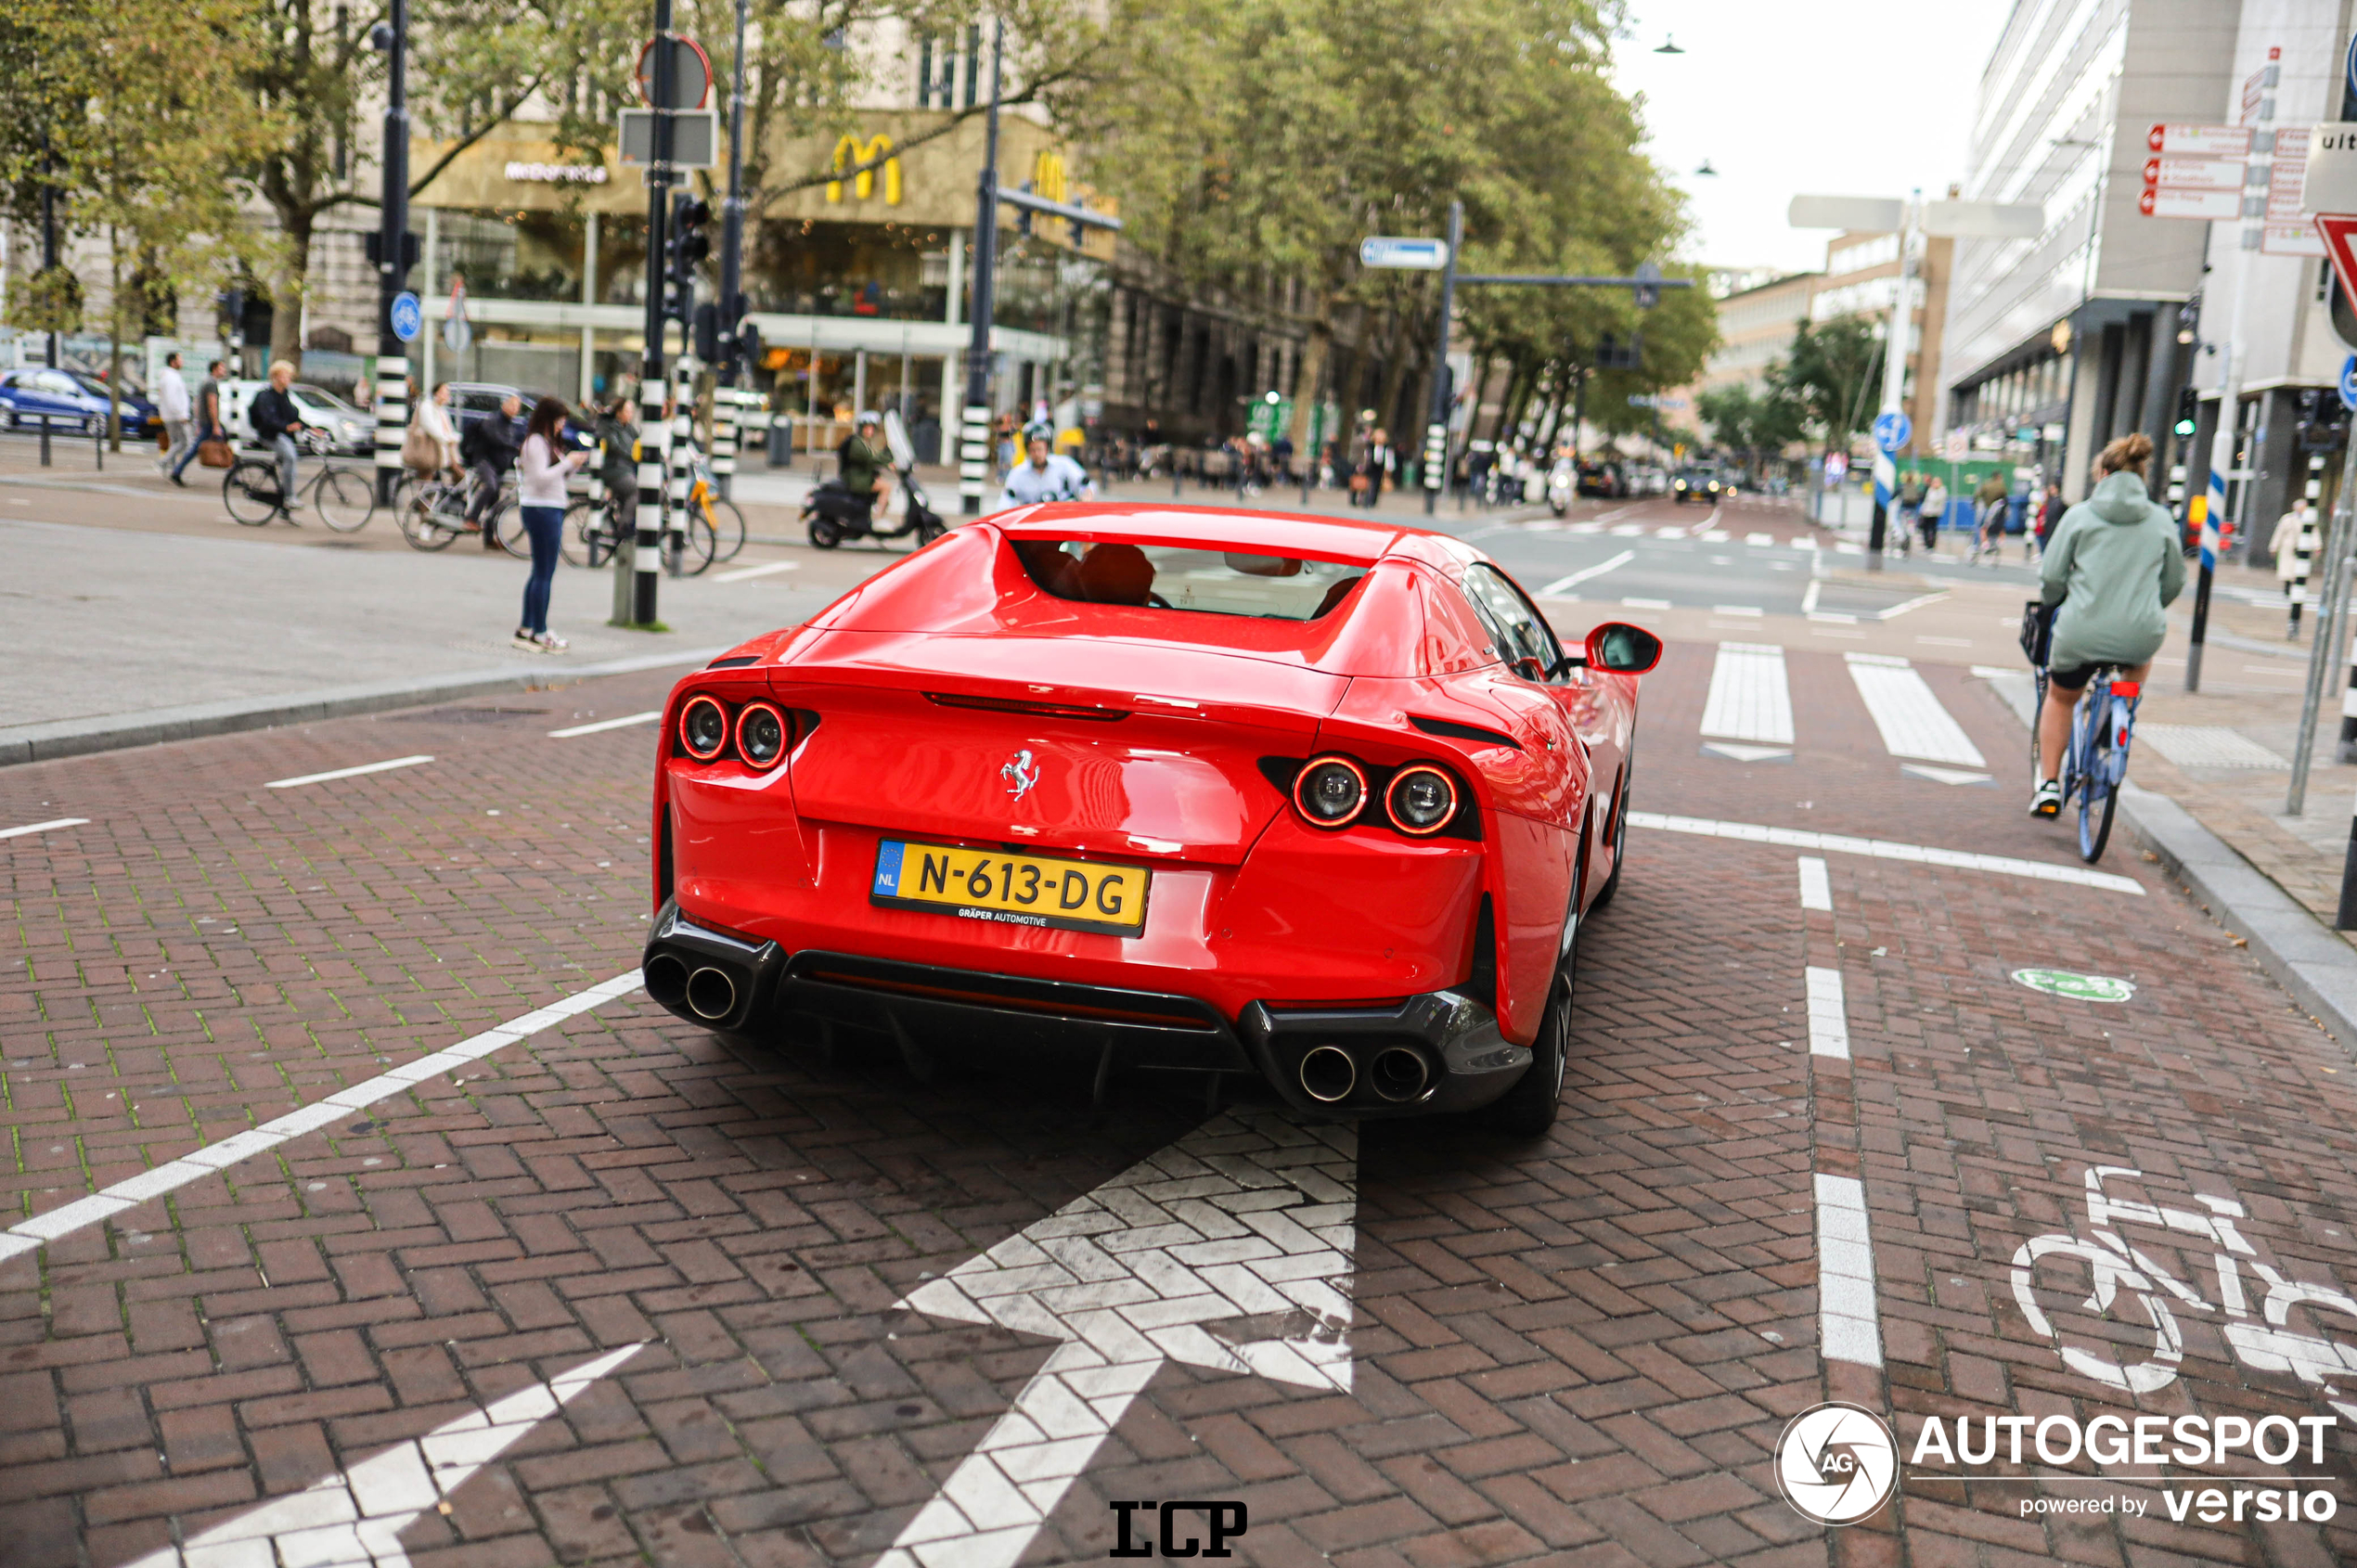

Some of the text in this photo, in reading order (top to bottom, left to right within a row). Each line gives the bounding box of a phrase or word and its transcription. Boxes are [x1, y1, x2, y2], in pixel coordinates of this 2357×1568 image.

[878, 872, 895, 887] NL
[919, 853, 1124, 916] N-613-DG
[958, 907, 1047, 927] GRÄPER AUTOMOTIVE
